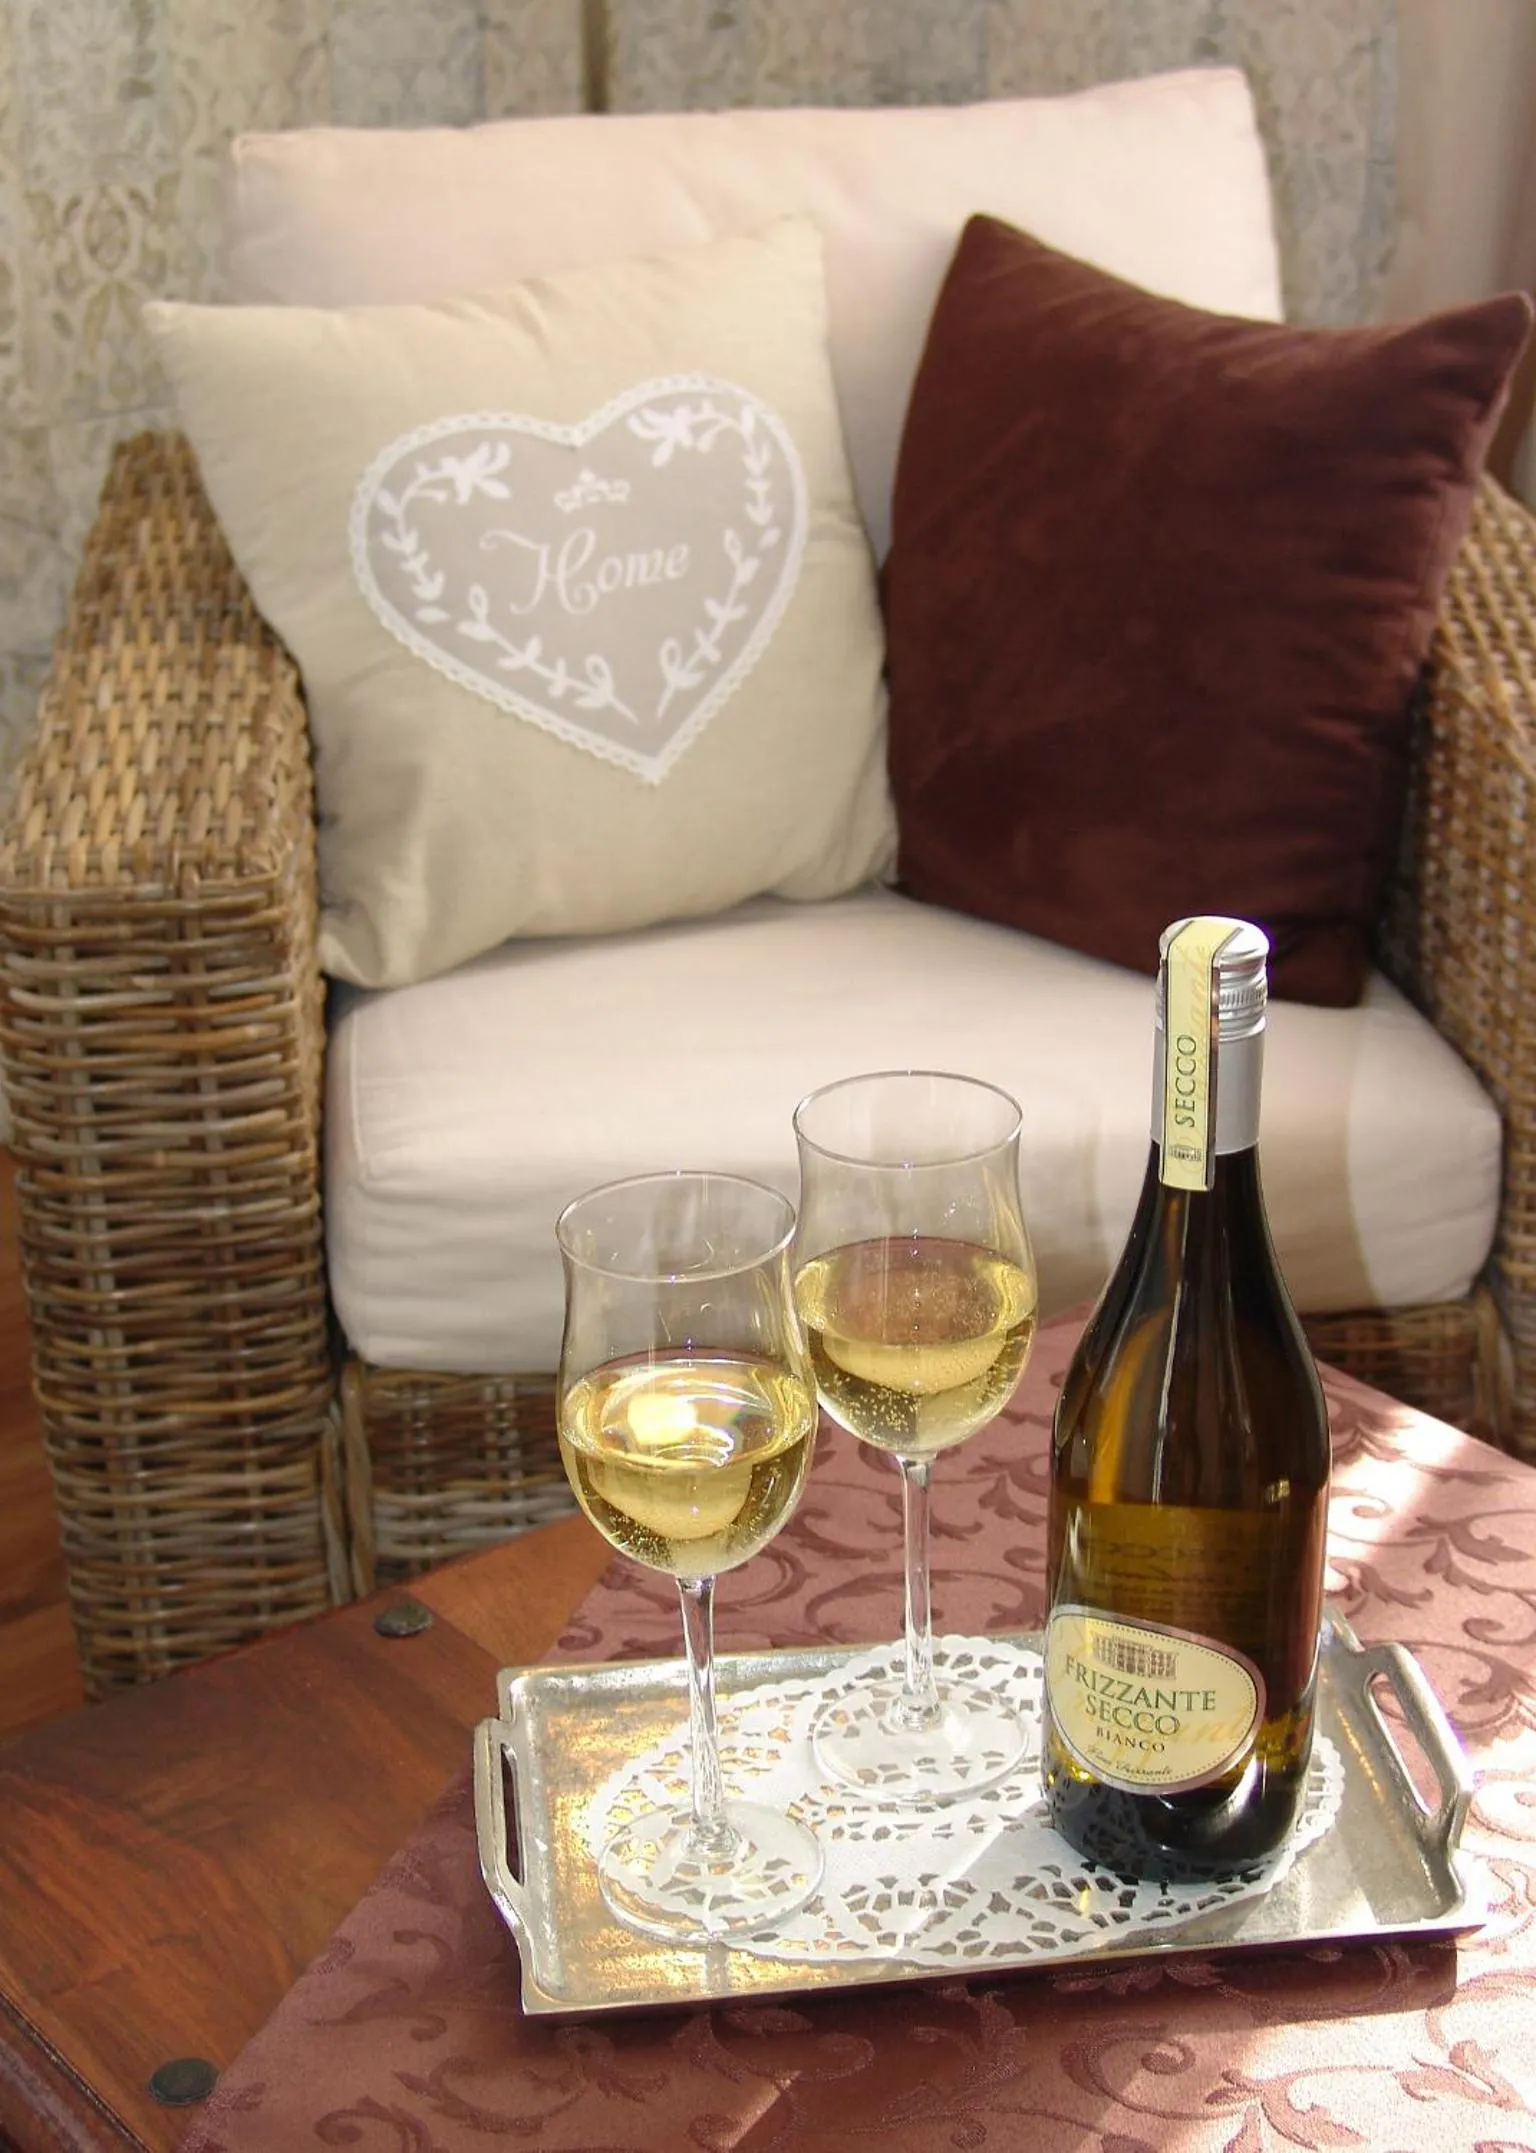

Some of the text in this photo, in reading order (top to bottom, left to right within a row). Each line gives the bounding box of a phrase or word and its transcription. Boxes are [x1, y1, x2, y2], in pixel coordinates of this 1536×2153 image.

[480, 527, 690, 615] Home
[1175, 1034, 1197, 1128] SECCO
[1065, 1653, 1217, 1712] FRIZZANTE
[1085, 1693, 1181, 1736] SECCO
[1096, 1727, 1166, 1753] BIANCO
